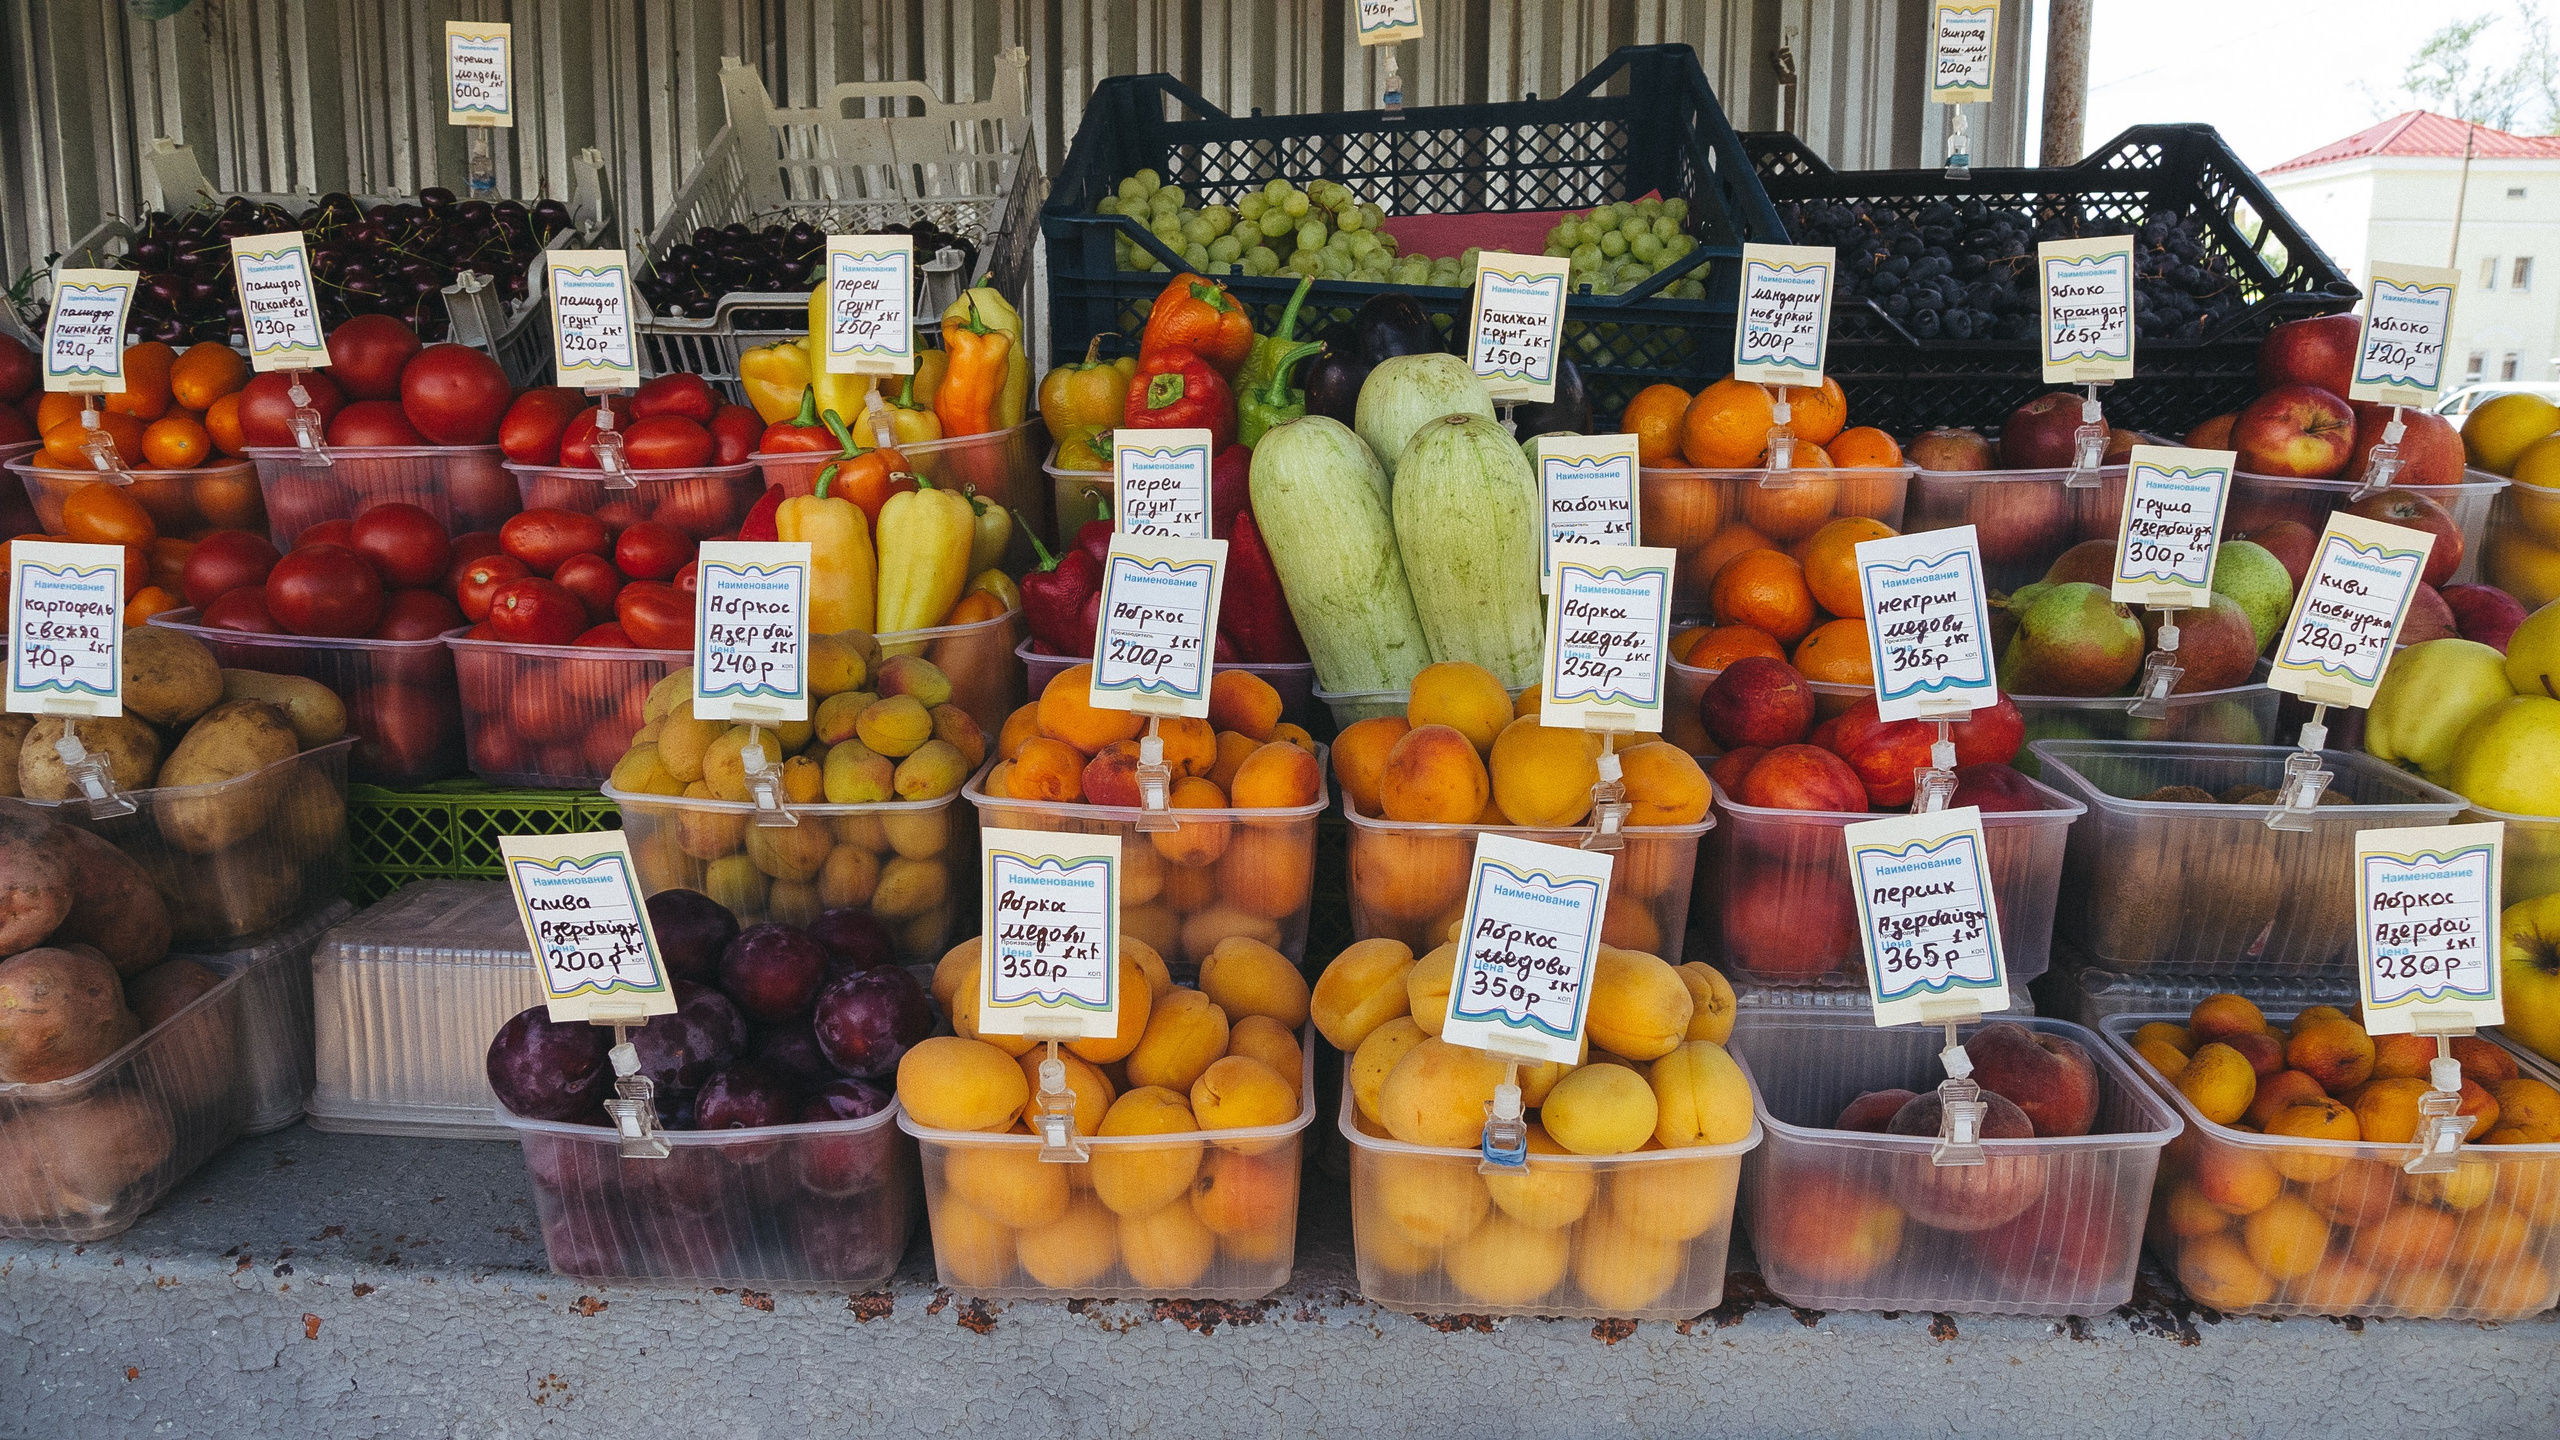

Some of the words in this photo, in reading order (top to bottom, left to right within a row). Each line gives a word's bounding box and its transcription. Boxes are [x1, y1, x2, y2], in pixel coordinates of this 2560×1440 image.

[1365, 5, 1394, 17] 450р
[454, 56, 493, 65] черешня
[1940, 62, 1971, 75] 200р
[456, 83, 489, 99] 600р
[1758, 275, 1816, 285] Наименование
[2058, 269, 2117, 278] Наименование
[1492, 285, 1549, 296] Наименование
[837, 299, 884, 318] грунт
[255, 320, 295, 338] 230р
[562, 315, 598, 329] грунт
[835, 320, 881, 339] 150р
[565, 334, 607, 352] 220р
[1749, 331, 1794, 353] 300р
[2053, 328, 2101, 344] 165р
[57, 340, 95, 362] 220р
[1484, 347, 1536, 374] 150р
[2366, 342, 2416, 370] 120р
[1556, 472, 1620, 480] Наименование
[2146, 481, 2211, 492] Наименование
[1128, 498, 1176, 519] грунт
[2137, 498, 2191, 519] груша
[2130, 542, 2185, 567] 300р
[2334, 554, 2402, 578] Наименование
[34, 580, 105, 592] Наименование
[717, 581, 790, 590] Наименование
[1124, 573, 1198, 588] Наименование
[1882, 571, 1960, 589] Наименование
[1574, 584, 1650, 596] Наименование
[25, 599, 114, 618] картофель
[1877, 591, 1957, 615] нектрин
[2297, 624, 2357, 656] 280р
[26, 645, 75, 675] 70р
[1109, 639, 1173, 675] 200р
[1892, 648, 1948, 671] 365р
[712, 652, 774, 682] 240р
[1562, 657, 1622, 687] 250р
[1876, 856, 1962, 876] Наименование
[2381, 868, 2473, 883] Наименование
[533, 875, 613, 887] Наименование
[1009, 874, 1095, 888] Наименование
[530, 895, 592, 911] слива
[1493, 884, 1580, 909] Наименование
[1873, 880, 1956, 908] персик
[1885, 942, 1960, 972] 365р
[2377, 947, 2409, 957] Цена
[550, 950, 622, 974] 200р
[1003, 954, 1068, 982] 350р
[1473, 959, 1504, 974] Цена
[2376, 955, 2461, 979] 280р
[1472, 970, 1540, 1011] 350р
